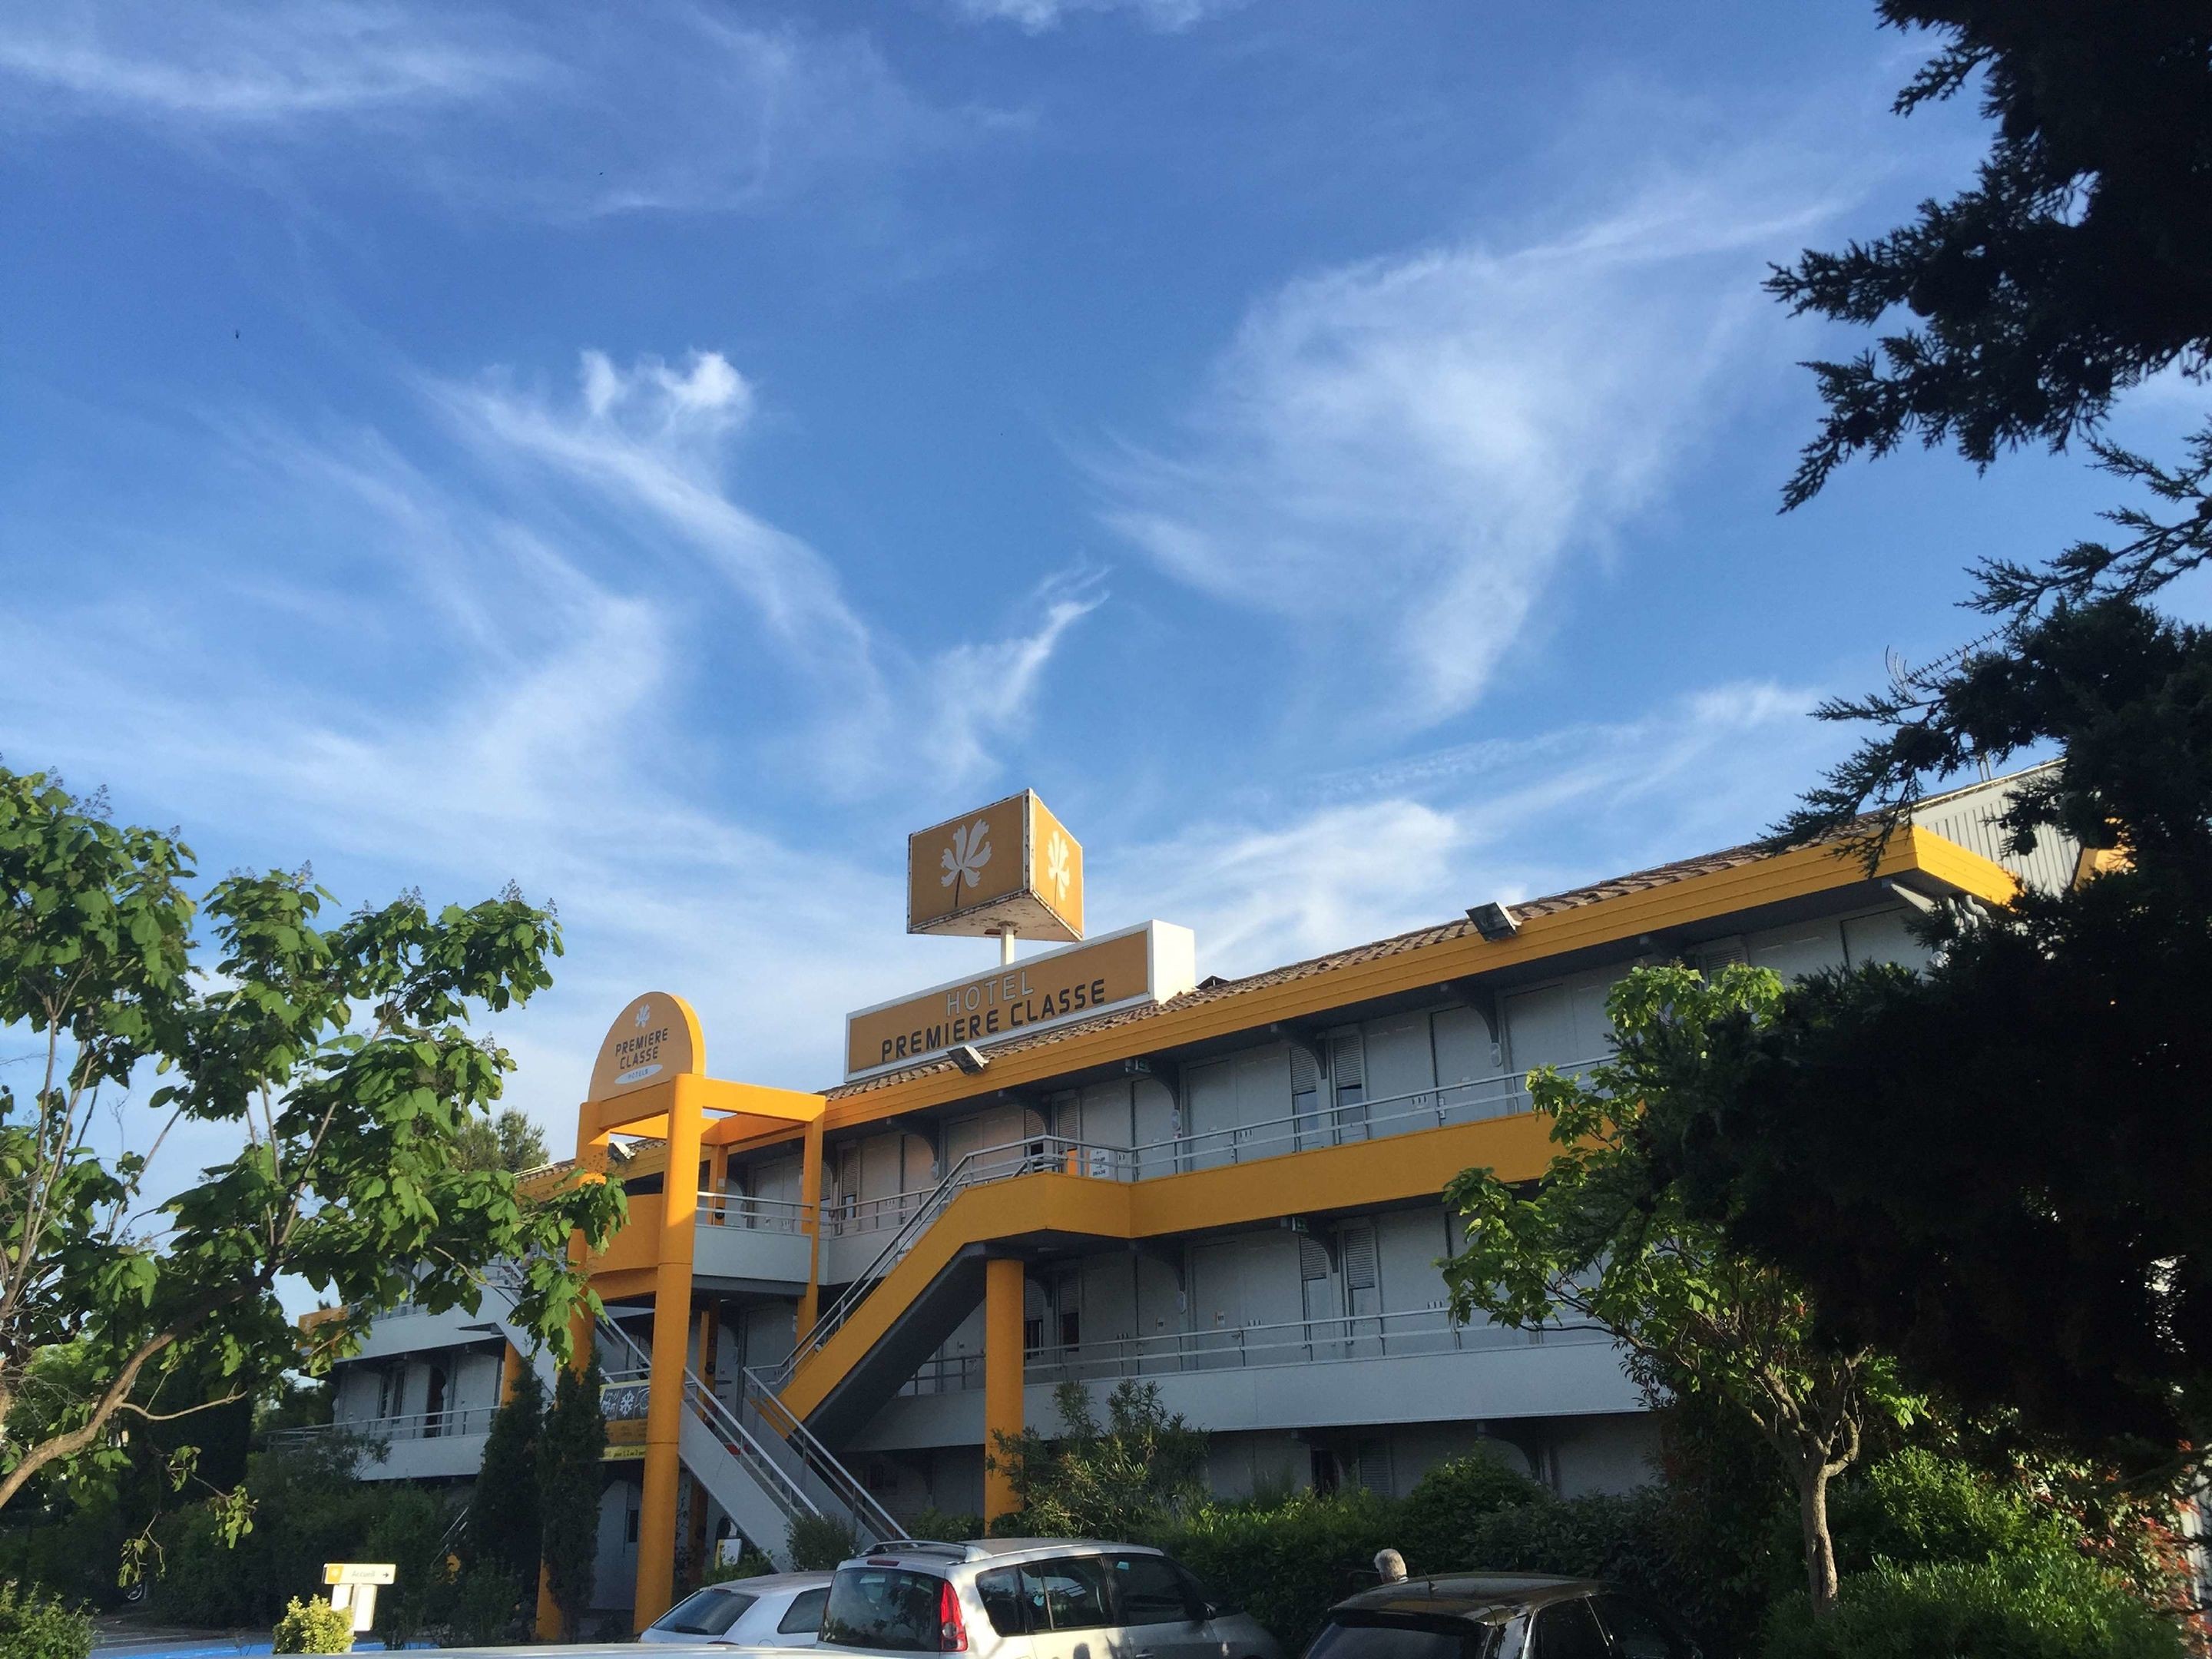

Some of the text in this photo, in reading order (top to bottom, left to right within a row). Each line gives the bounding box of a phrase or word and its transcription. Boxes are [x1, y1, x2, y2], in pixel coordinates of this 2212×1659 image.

[945, 971, 1035, 1016] HOTEL
[881, 979, 1104, 1062] PREMIERE CLASSE
[615, 1028, 668, 1057] PREMIERE
[620, 1046, 658, 1069] CLASSE
